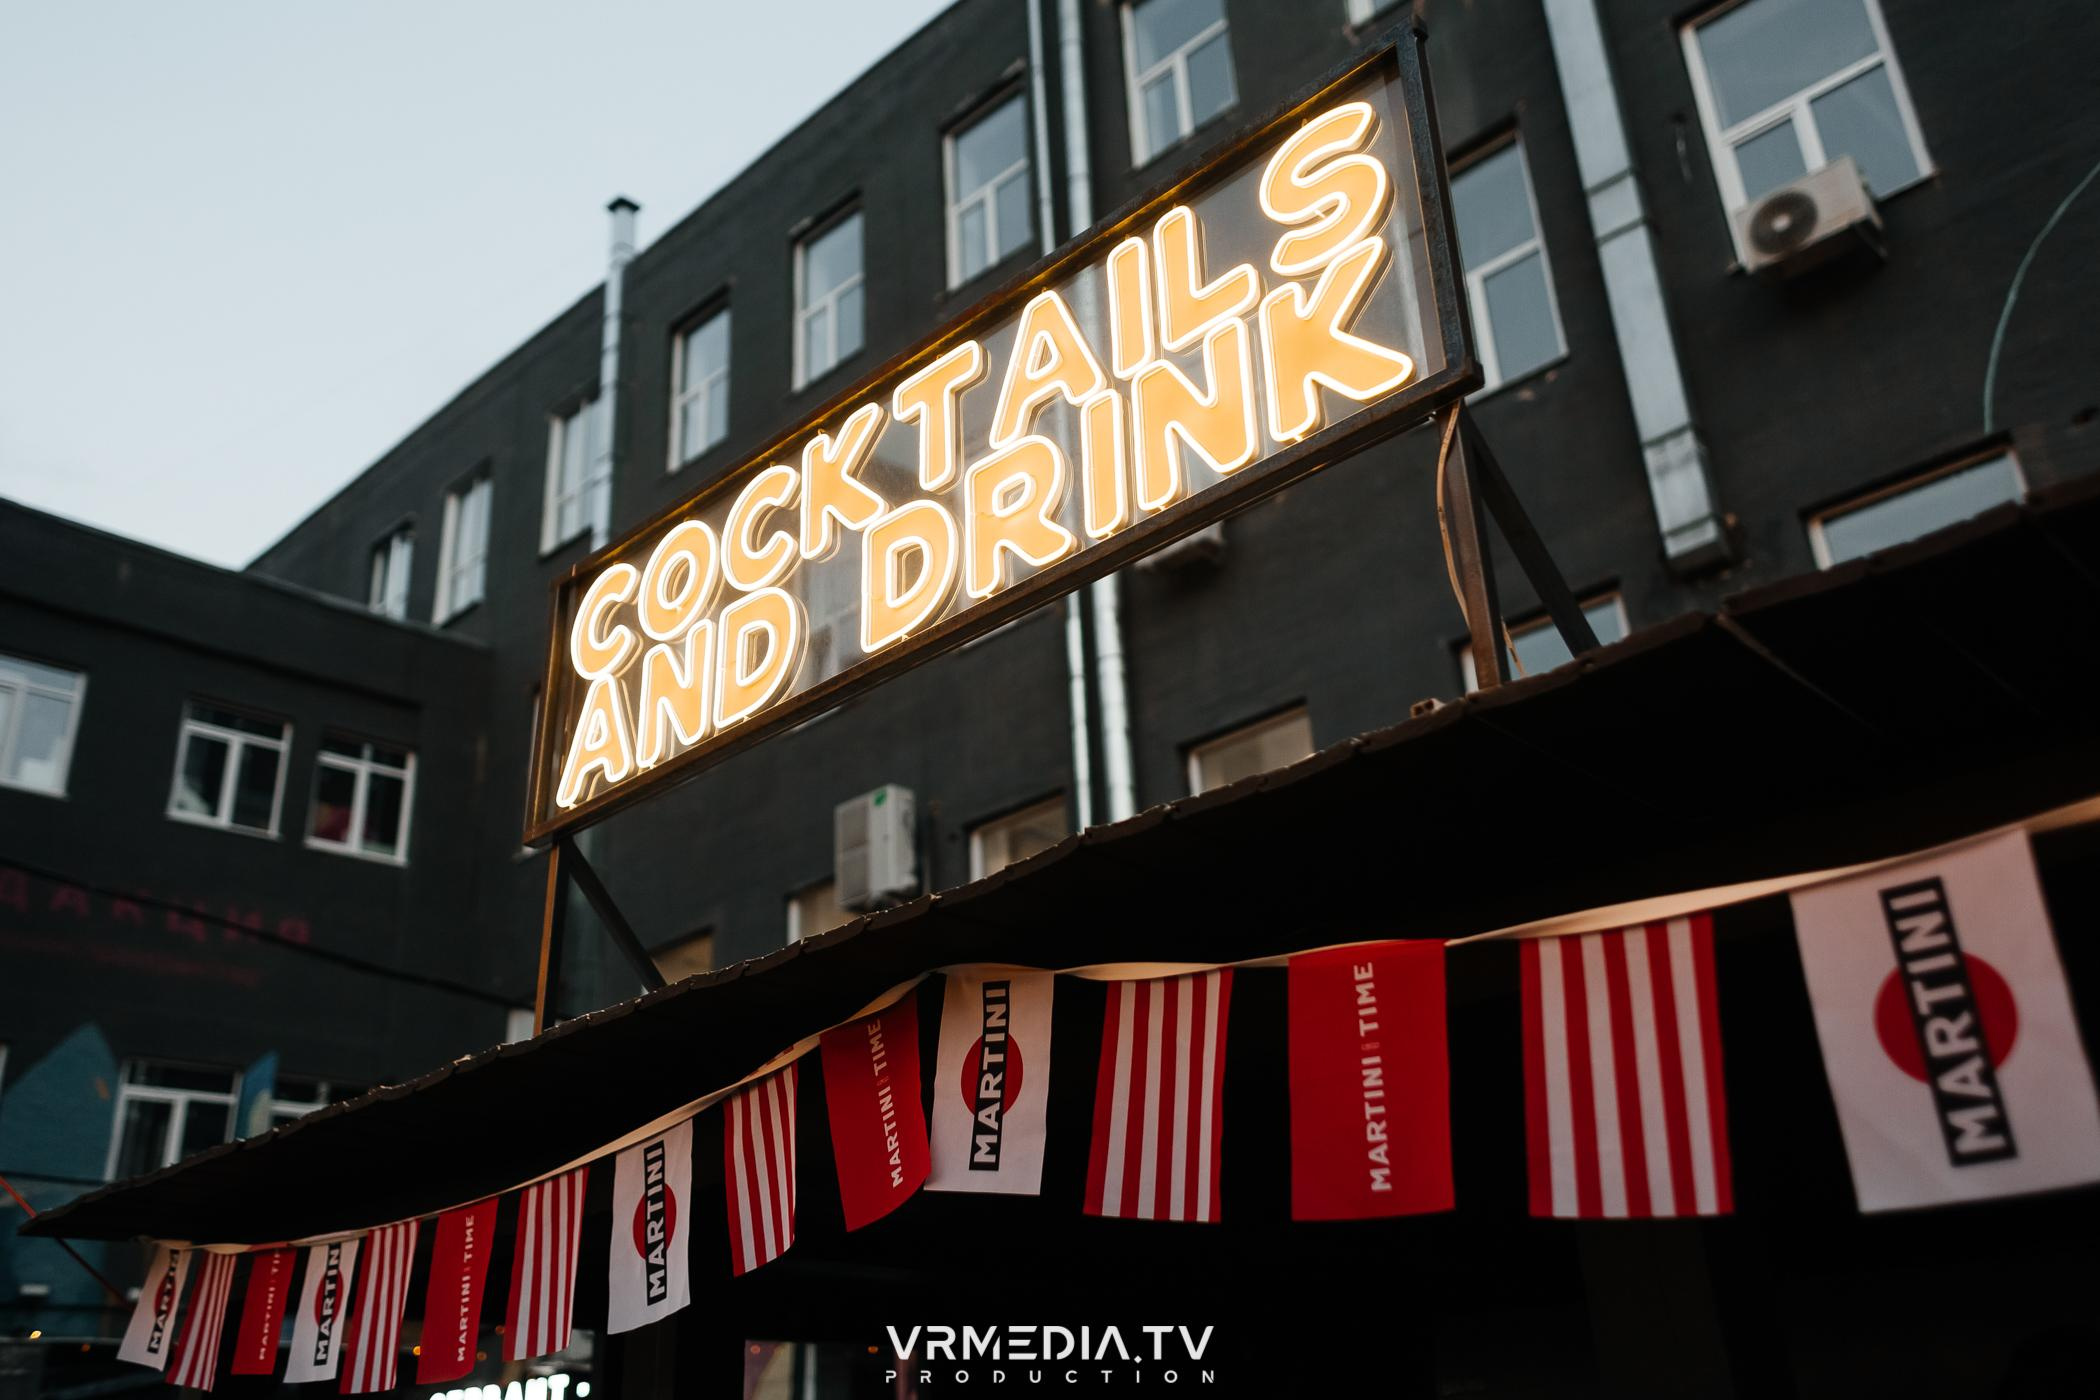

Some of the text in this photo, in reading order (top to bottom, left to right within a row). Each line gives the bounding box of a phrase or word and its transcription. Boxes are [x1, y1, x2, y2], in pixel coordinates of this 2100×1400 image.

[571, 101, 1393, 682] COCKTAILS
[556, 235, 1416, 809] AND DRINK
[868, 1017, 888, 1077] TIME
[1353, 962, 1379, 1037] TIME
[1888, 886, 2009, 1156] MARTINI
[878, 1085, 904, 1188] MARTINI
[973, 988, 1007, 1163] MARTINI
[1361, 1056, 1392, 1192] MARTINI
[456, 1214, 475, 1363] MARTINI TIME
[646, 1147, 665, 1298] MARTINI
[316, 1248, 341, 1361] MARTIN
